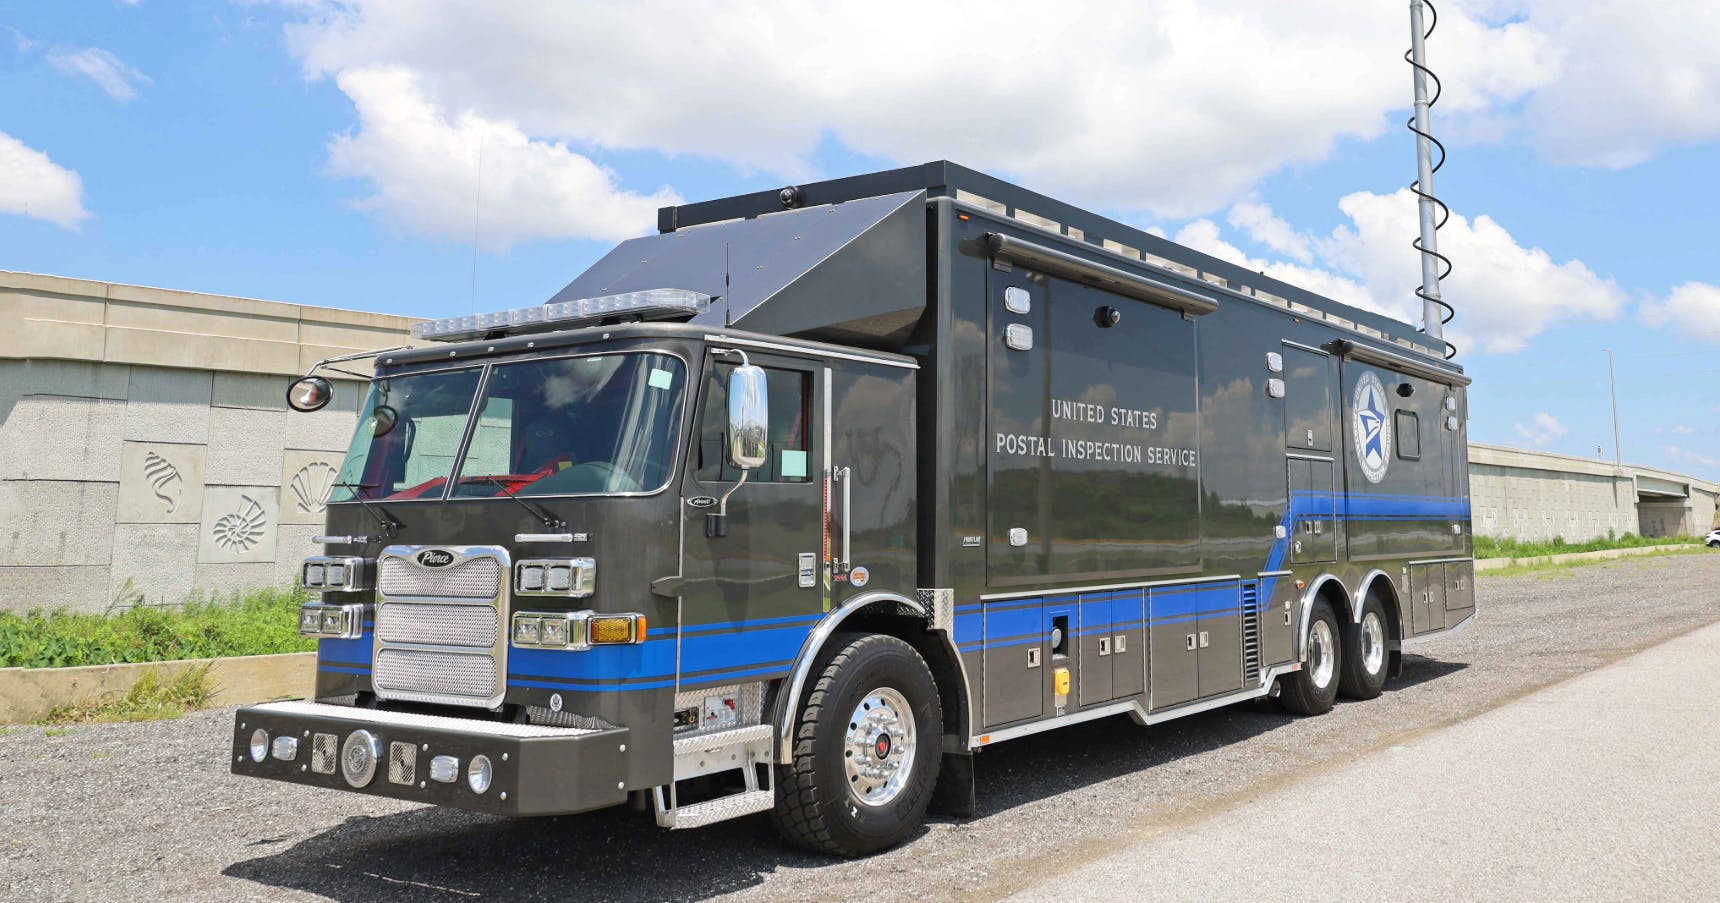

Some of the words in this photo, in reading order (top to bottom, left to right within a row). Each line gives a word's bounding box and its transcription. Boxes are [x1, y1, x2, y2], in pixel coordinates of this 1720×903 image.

[1052, 399, 1105, 423] UNITED
[1111, 407, 1157, 430] STATES
[996, 432, 1056, 457] POSTAL
[1062, 439, 1141, 463] INSPECTION
[1147, 446, 1196, 467] SERVICE
[421, 550, 450, 566] Pierce
